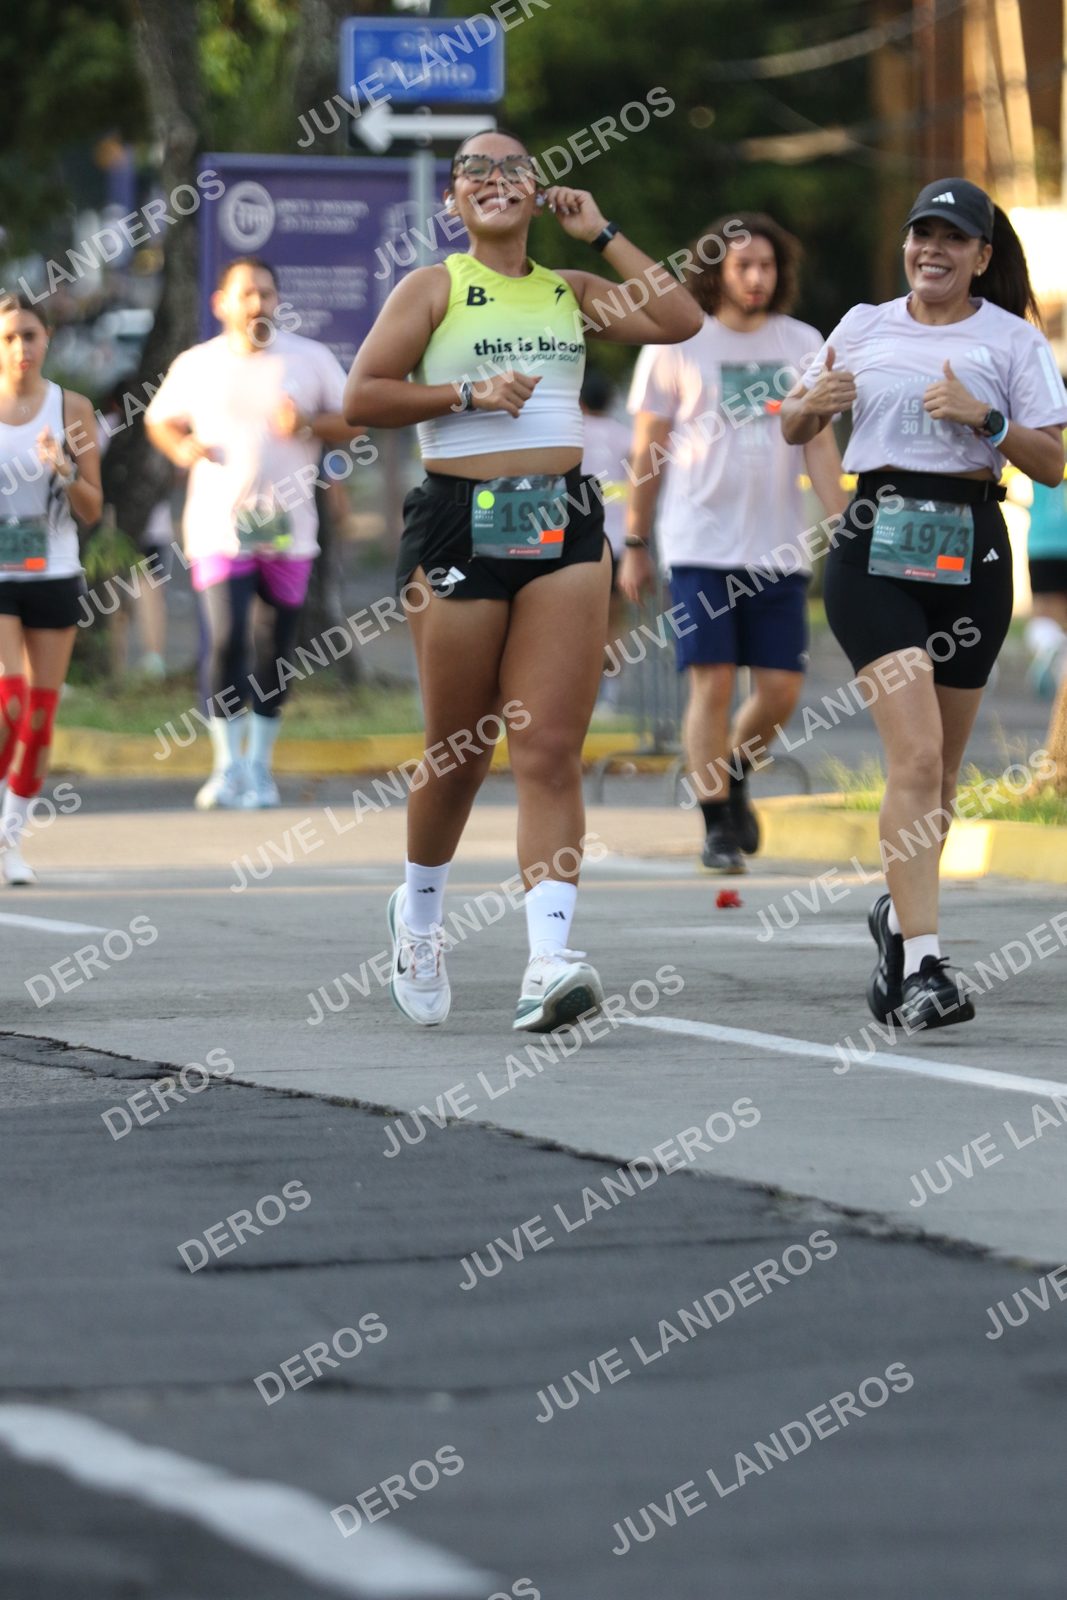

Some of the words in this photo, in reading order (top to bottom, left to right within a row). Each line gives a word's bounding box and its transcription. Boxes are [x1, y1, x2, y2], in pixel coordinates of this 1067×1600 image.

[474, 337, 512, 356] this
[519, 336, 532, 352] is
[531, 353, 556, 362] your
[902, 399, 919, 414] 15
[901, 420, 919, 435] 30
[899, 521, 970, 557] 1973
